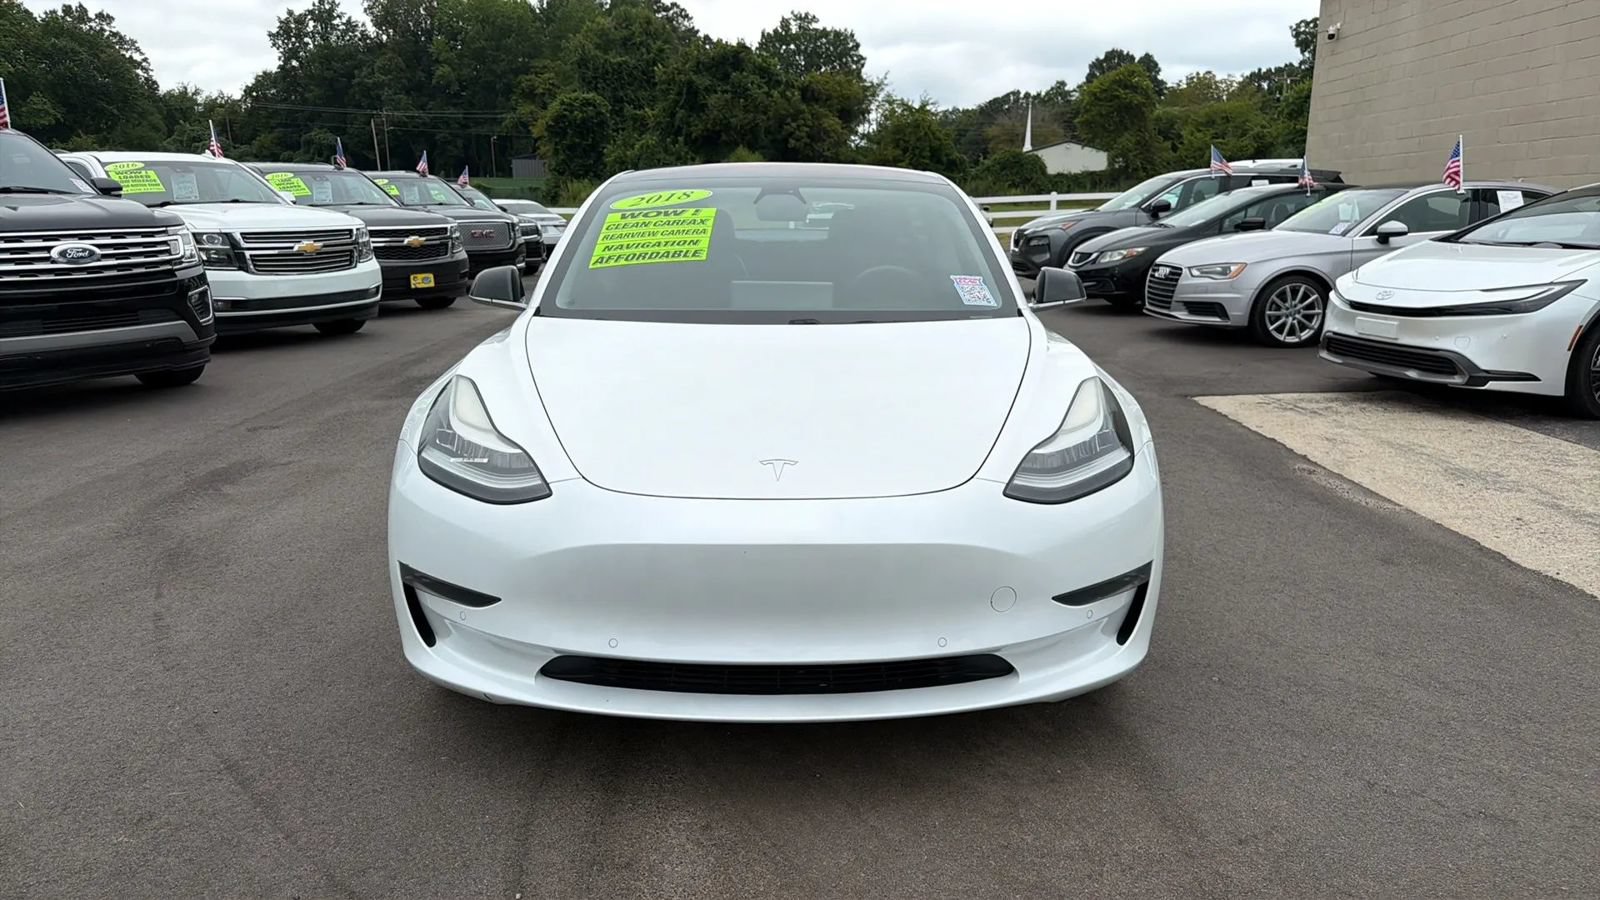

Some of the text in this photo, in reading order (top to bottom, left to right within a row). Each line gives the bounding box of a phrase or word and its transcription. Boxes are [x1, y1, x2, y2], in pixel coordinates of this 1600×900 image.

[628, 190, 695, 208] 2018
[619, 209, 690, 221] WOW
[605, 218, 709, 231] CLEAN CARFAX
[601, 228, 707, 242] REARVIEW CAMERA
[602, 239, 701, 253] NAVIGATION
[66, 248, 90, 259] Ford
[591, 249, 706, 266] AFFORDABLE
